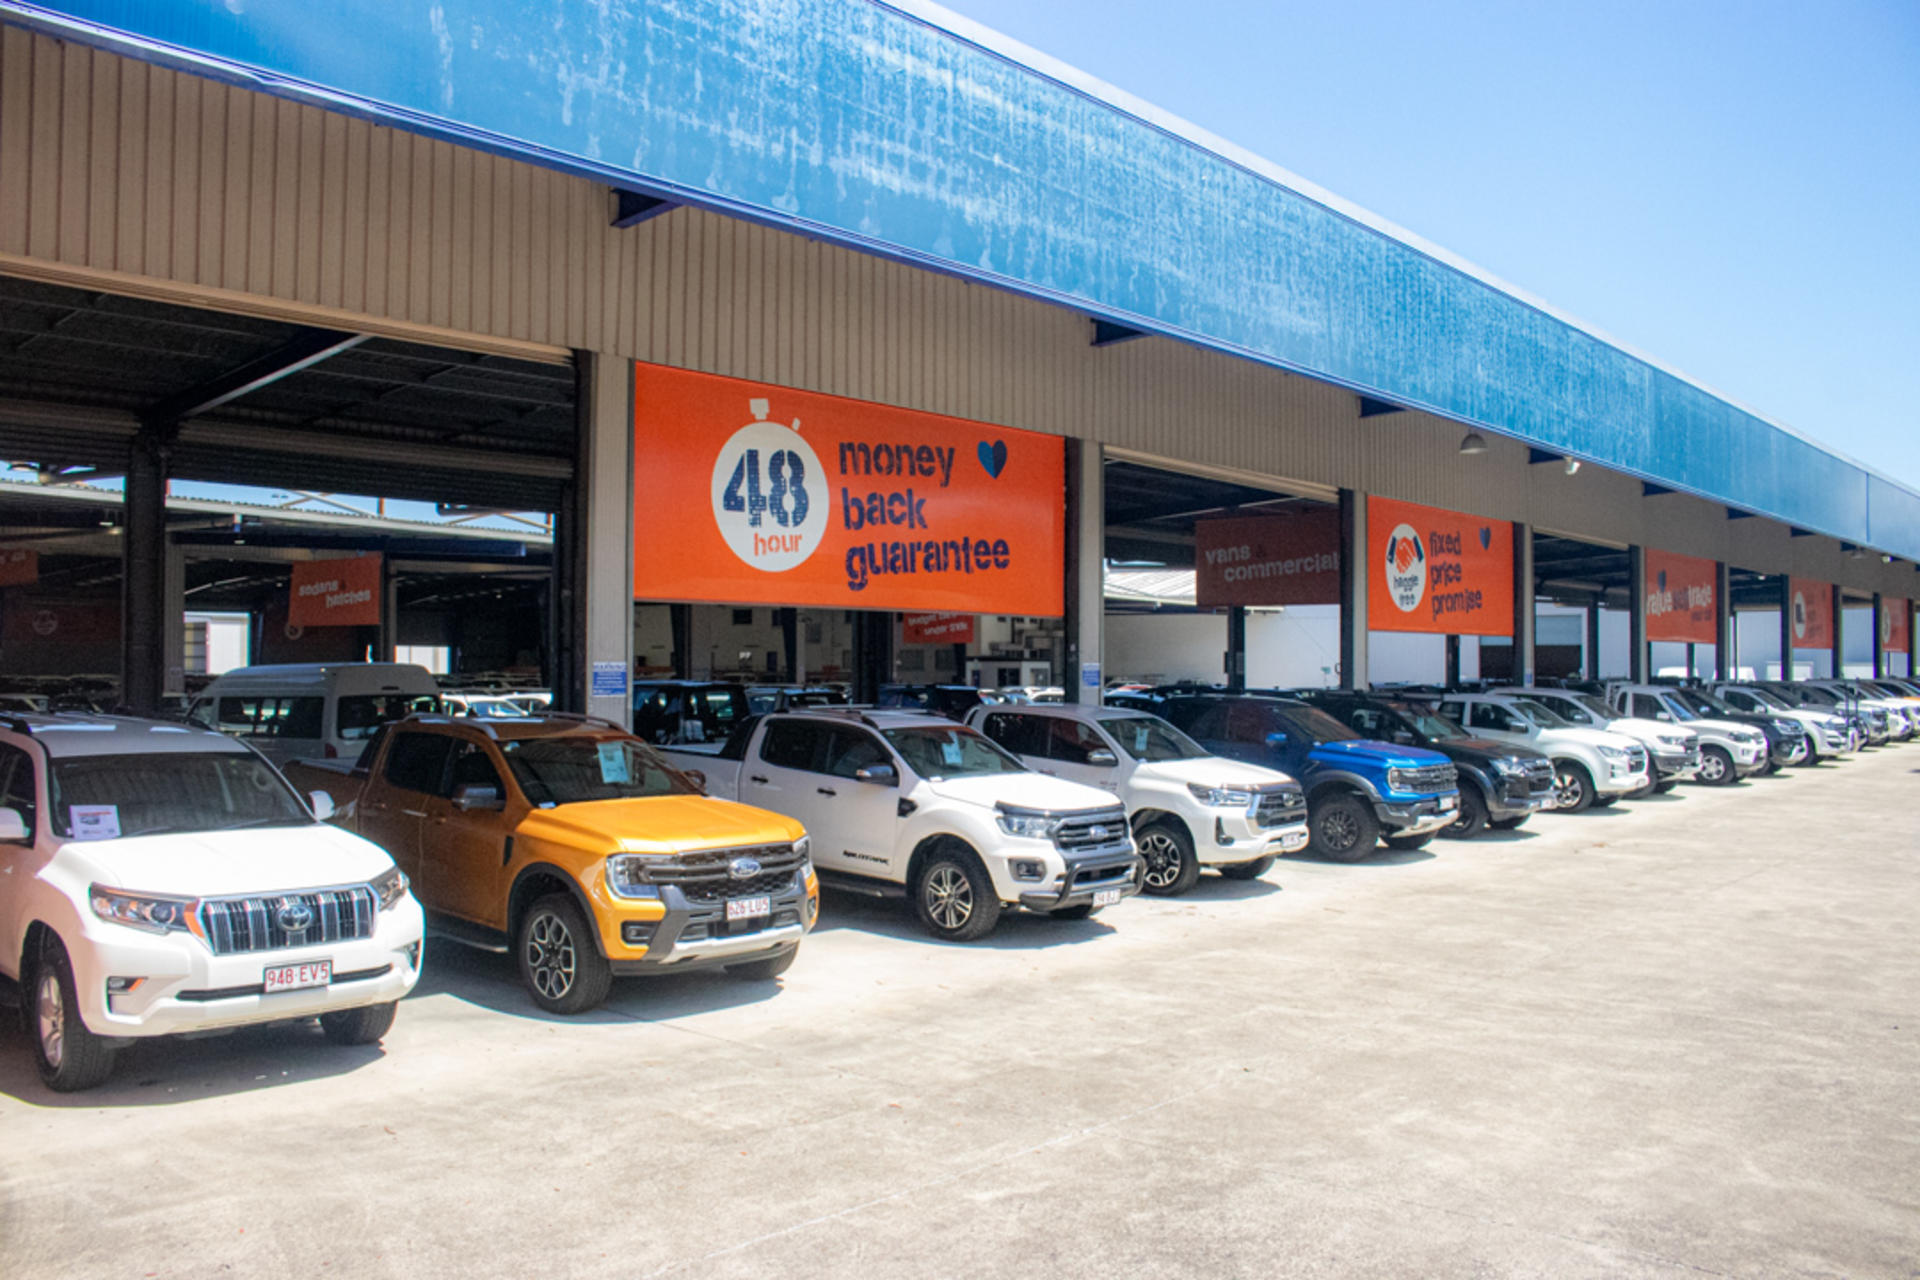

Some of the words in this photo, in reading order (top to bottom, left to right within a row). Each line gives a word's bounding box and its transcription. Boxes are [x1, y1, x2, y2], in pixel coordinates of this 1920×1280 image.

[839, 441, 955, 487] money
[723, 449, 809, 528] 48
[842, 487, 927, 530] back
[754, 532, 803, 556] hour
[1205, 545, 1251, 565] vans
[1429, 531, 1461, 557] fixed
[845, 536, 1010, 591] guarantee
[1430, 561, 1461, 592] price
[1432, 588, 1483, 622] promise
